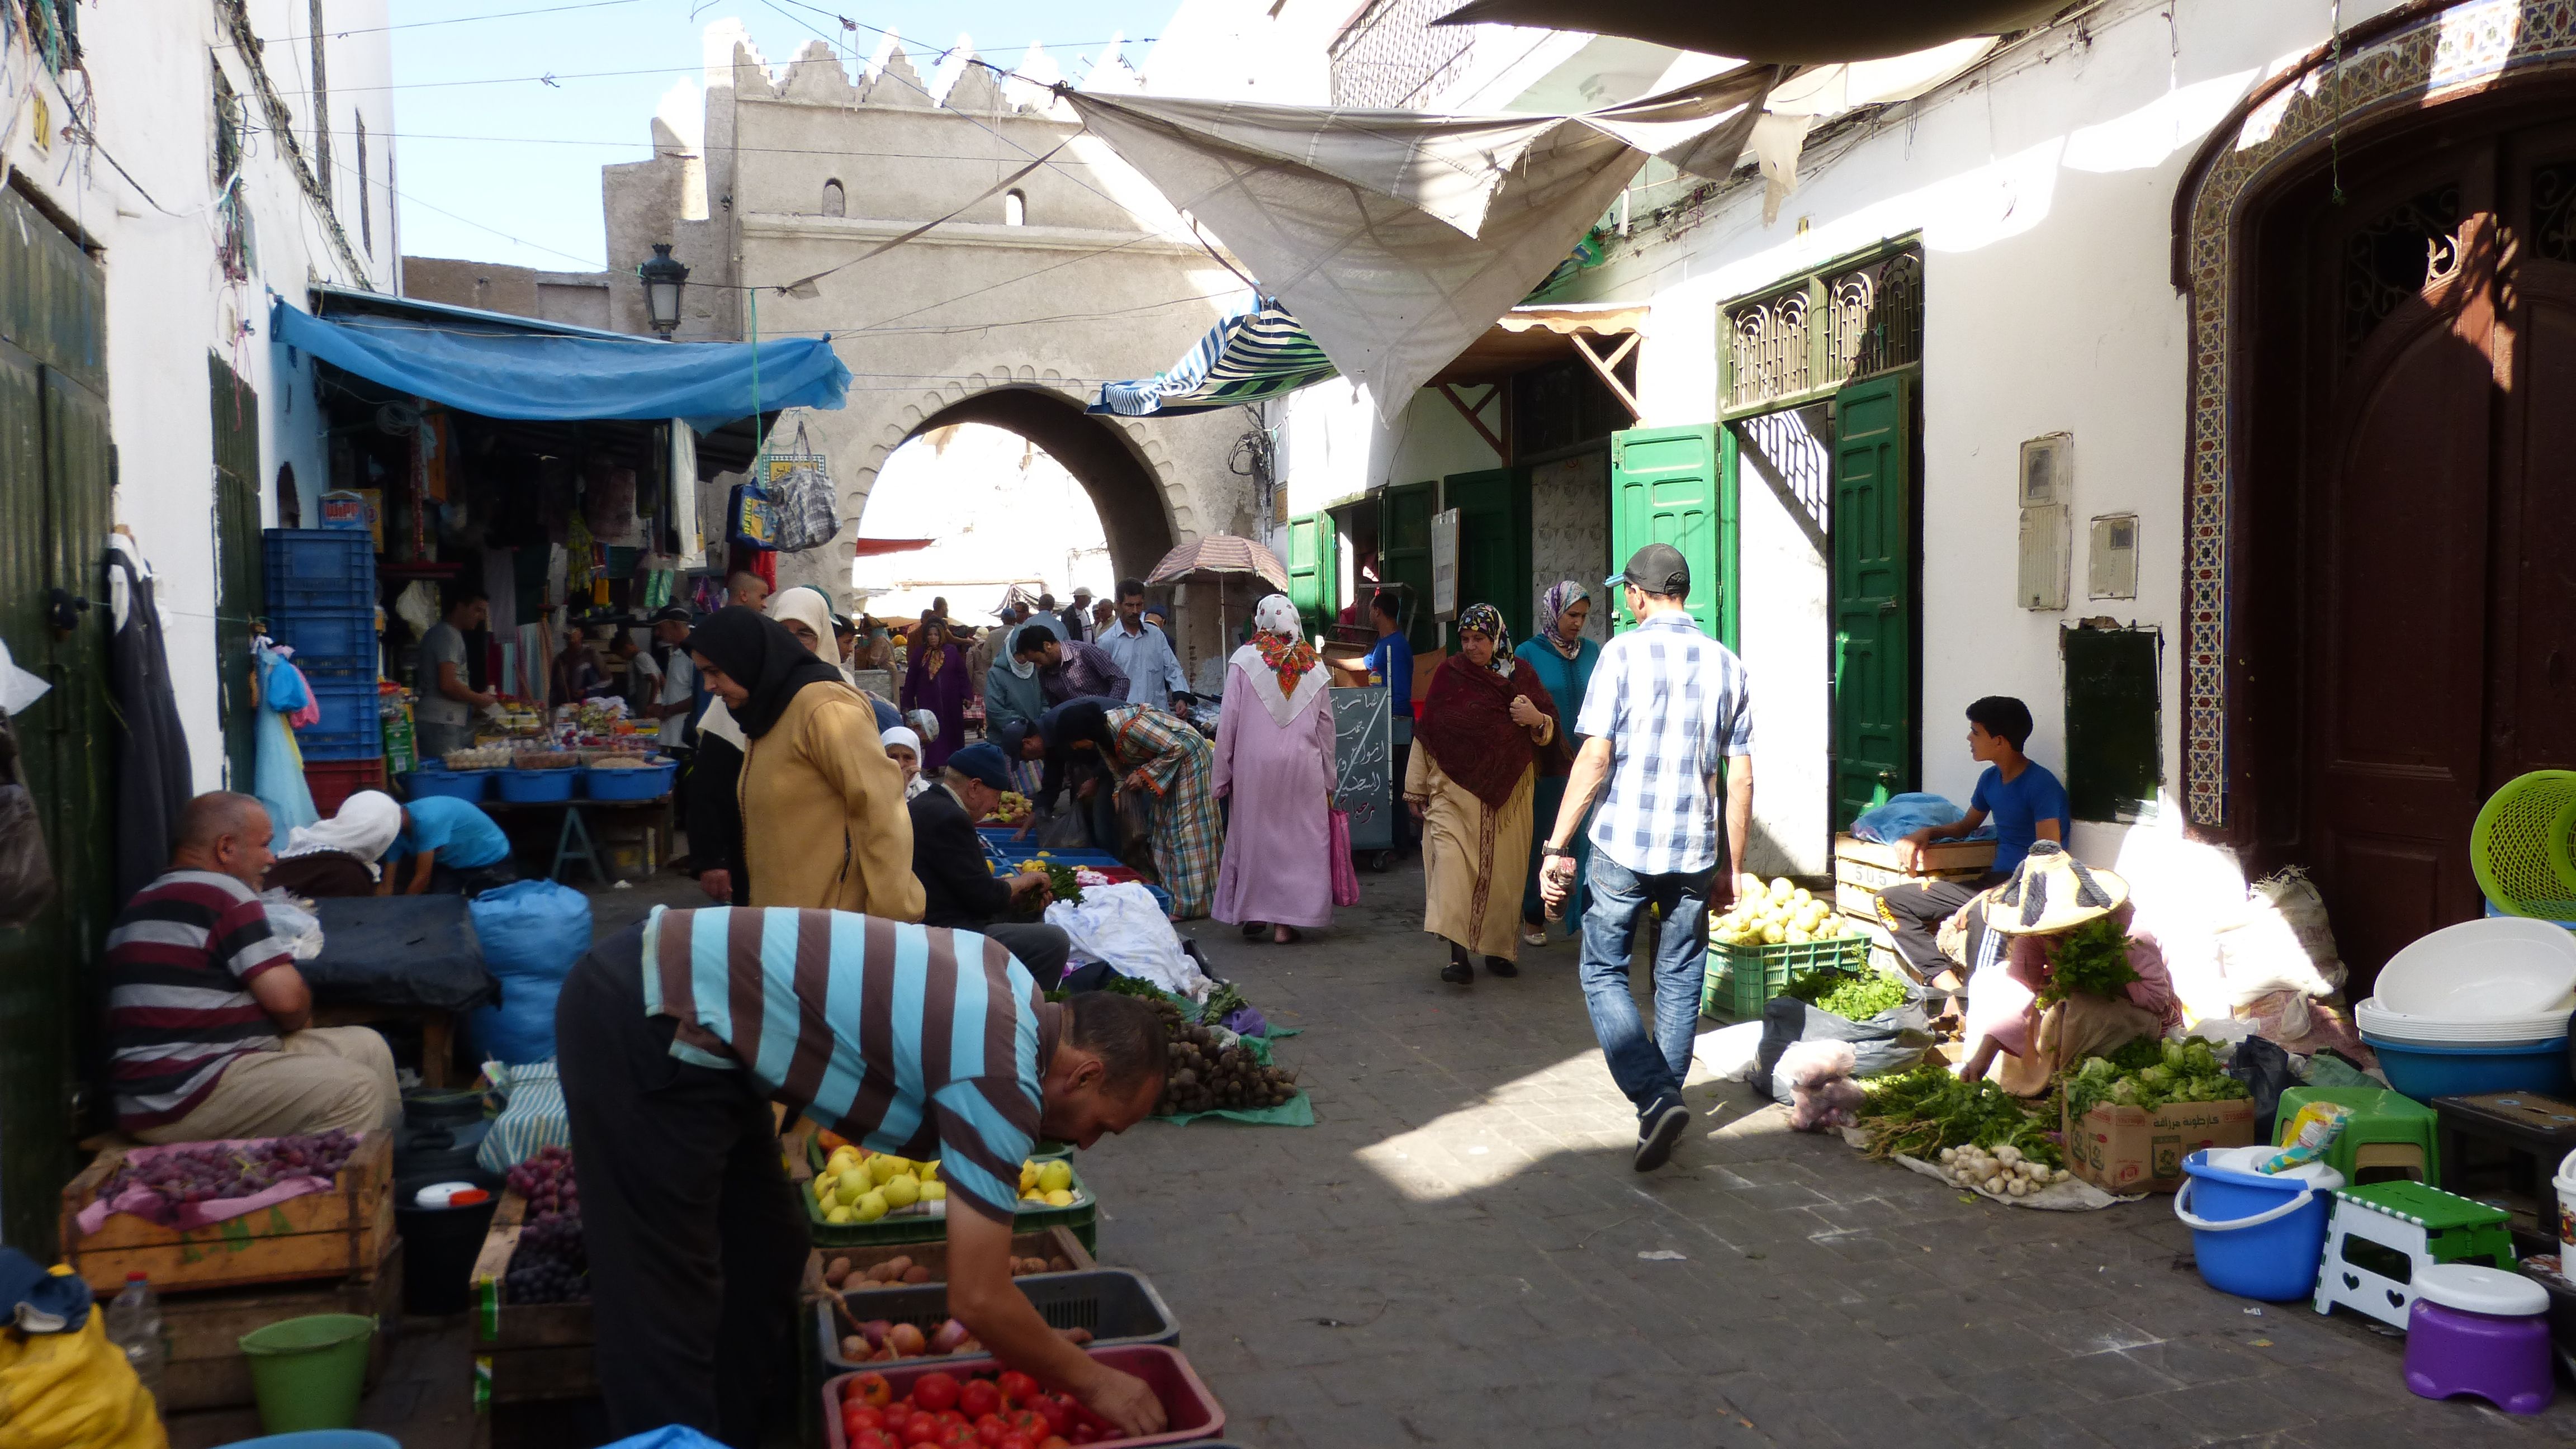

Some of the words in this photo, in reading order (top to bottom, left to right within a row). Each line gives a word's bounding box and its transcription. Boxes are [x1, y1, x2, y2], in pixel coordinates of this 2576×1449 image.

[742, 498, 753, 534] AFRICA
[1855, 865, 1887, 886] 505
[1871, 949, 1893, 969] 05
